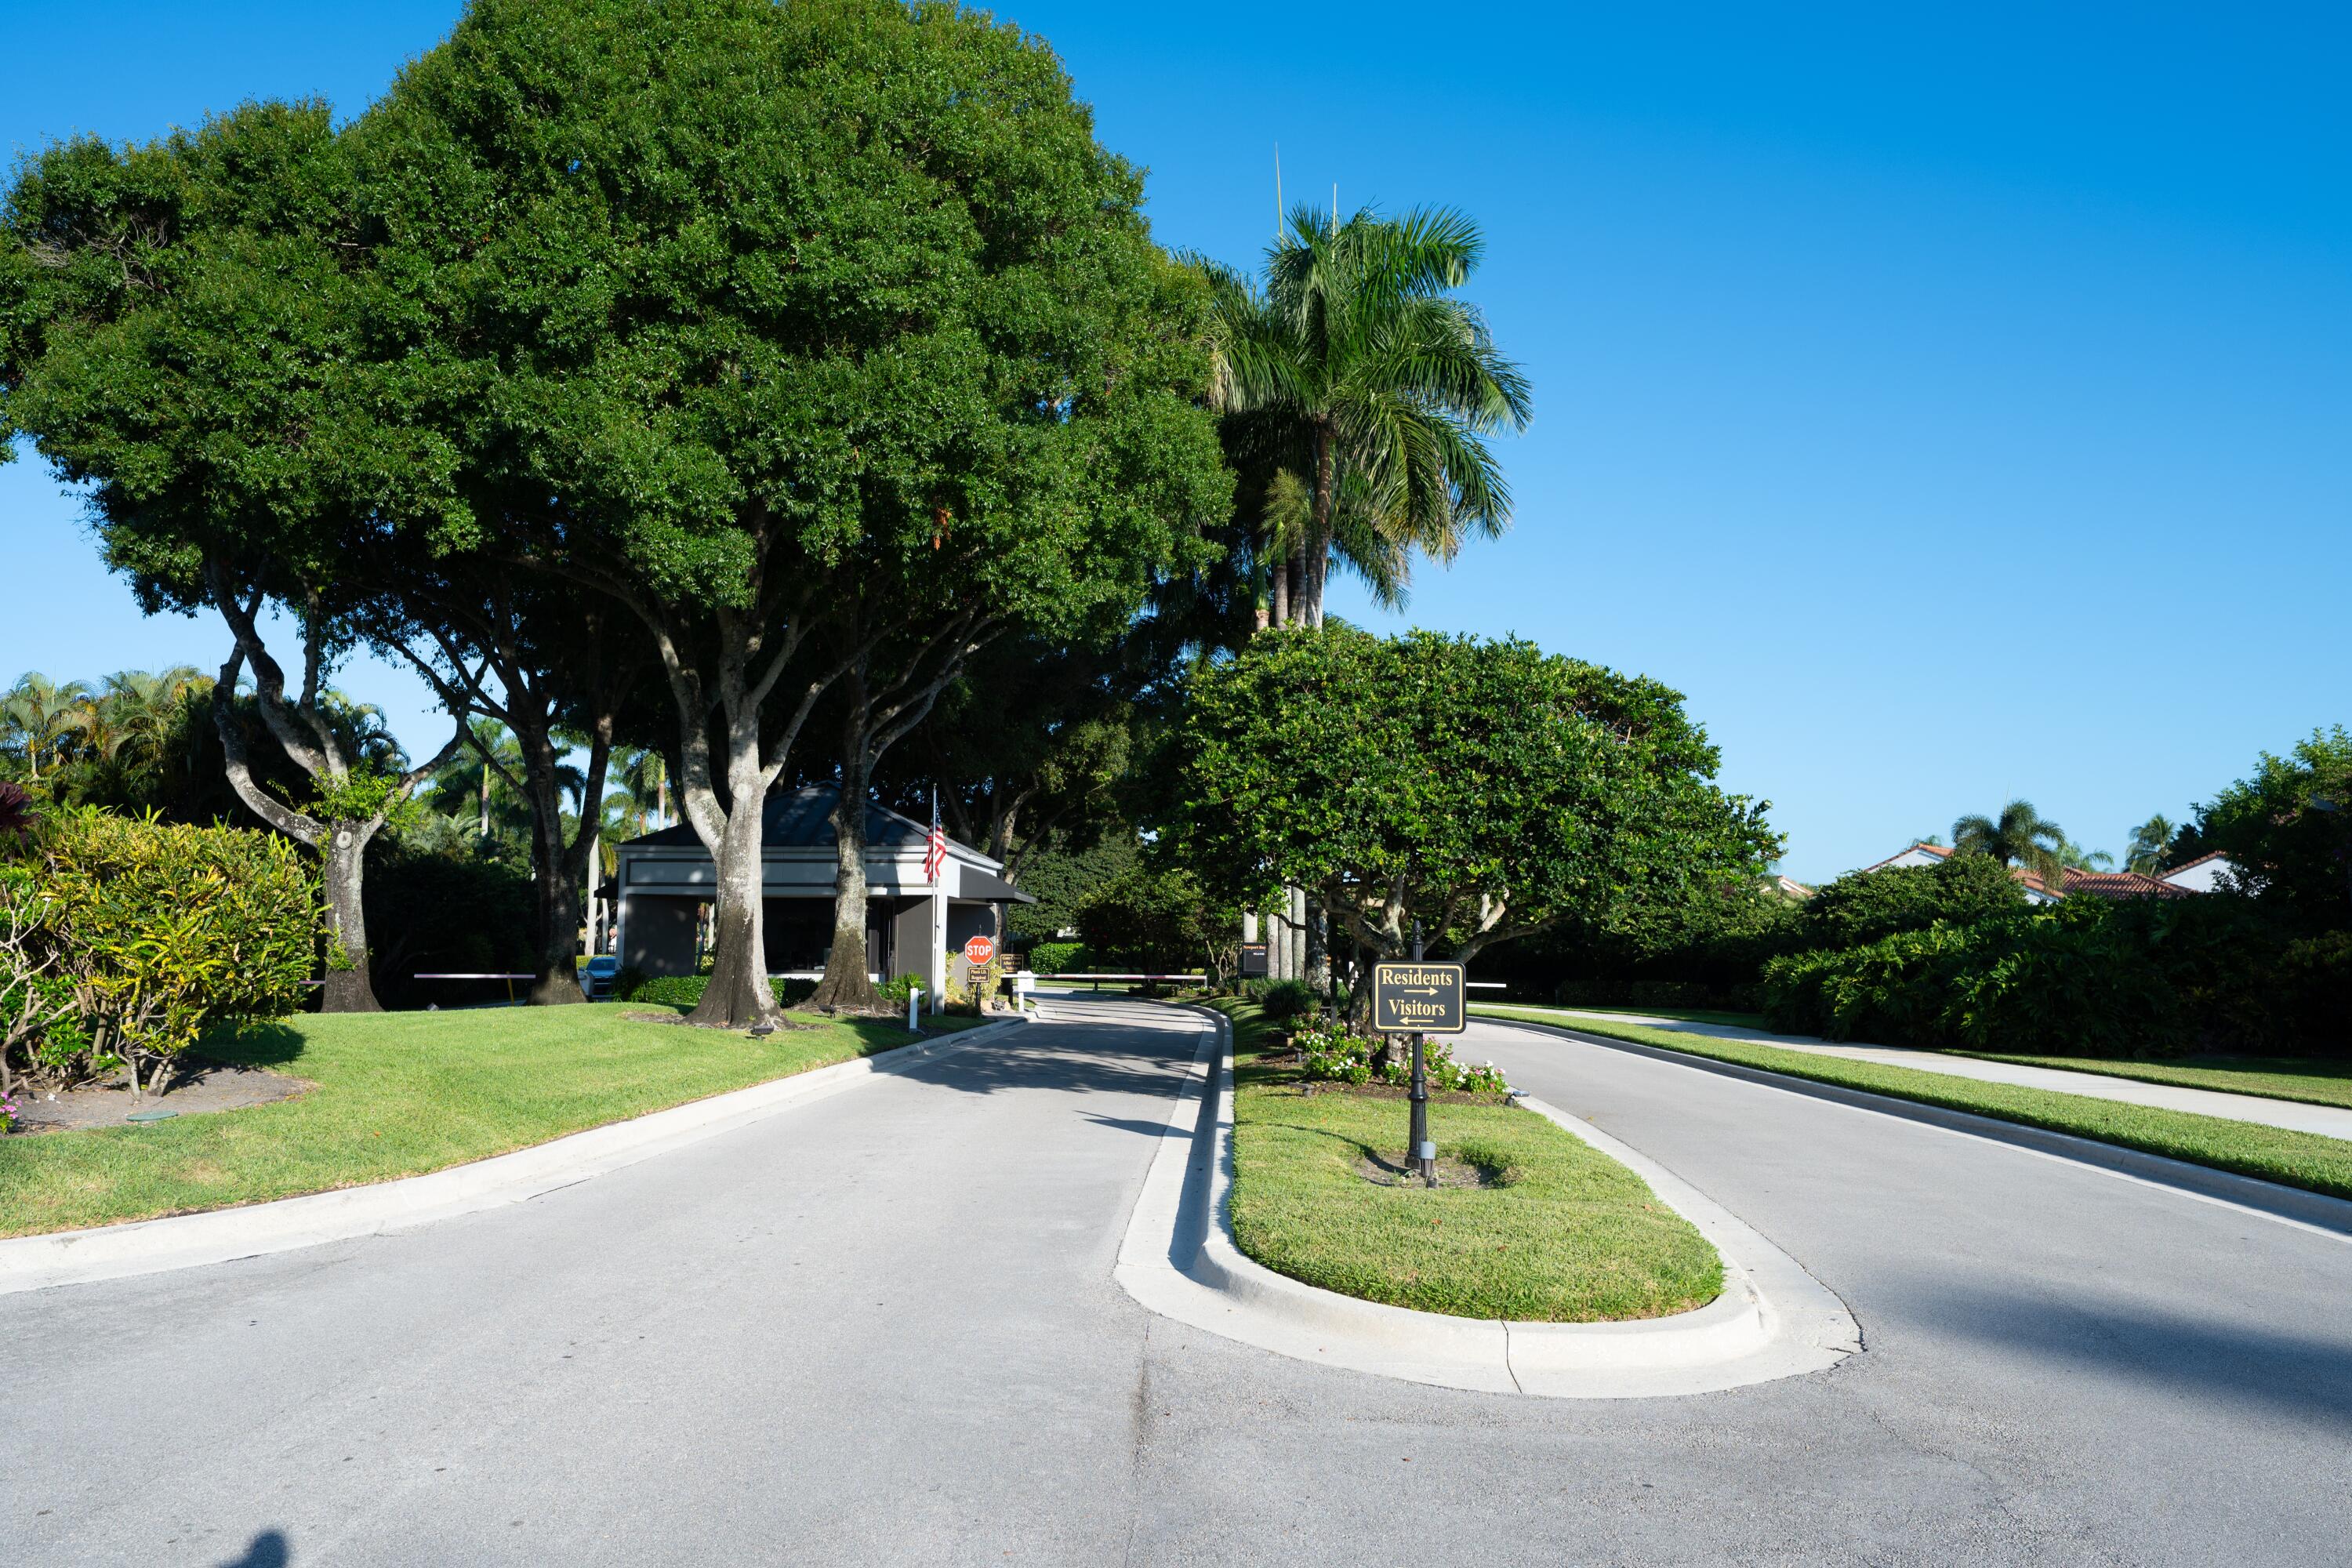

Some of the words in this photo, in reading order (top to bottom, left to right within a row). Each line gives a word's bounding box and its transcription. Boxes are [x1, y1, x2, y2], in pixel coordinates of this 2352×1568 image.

[967, 945, 992, 956] STOP
[1381, 967, 1453, 986] Residents
[1388, 999, 1446, 1016] Visitors
